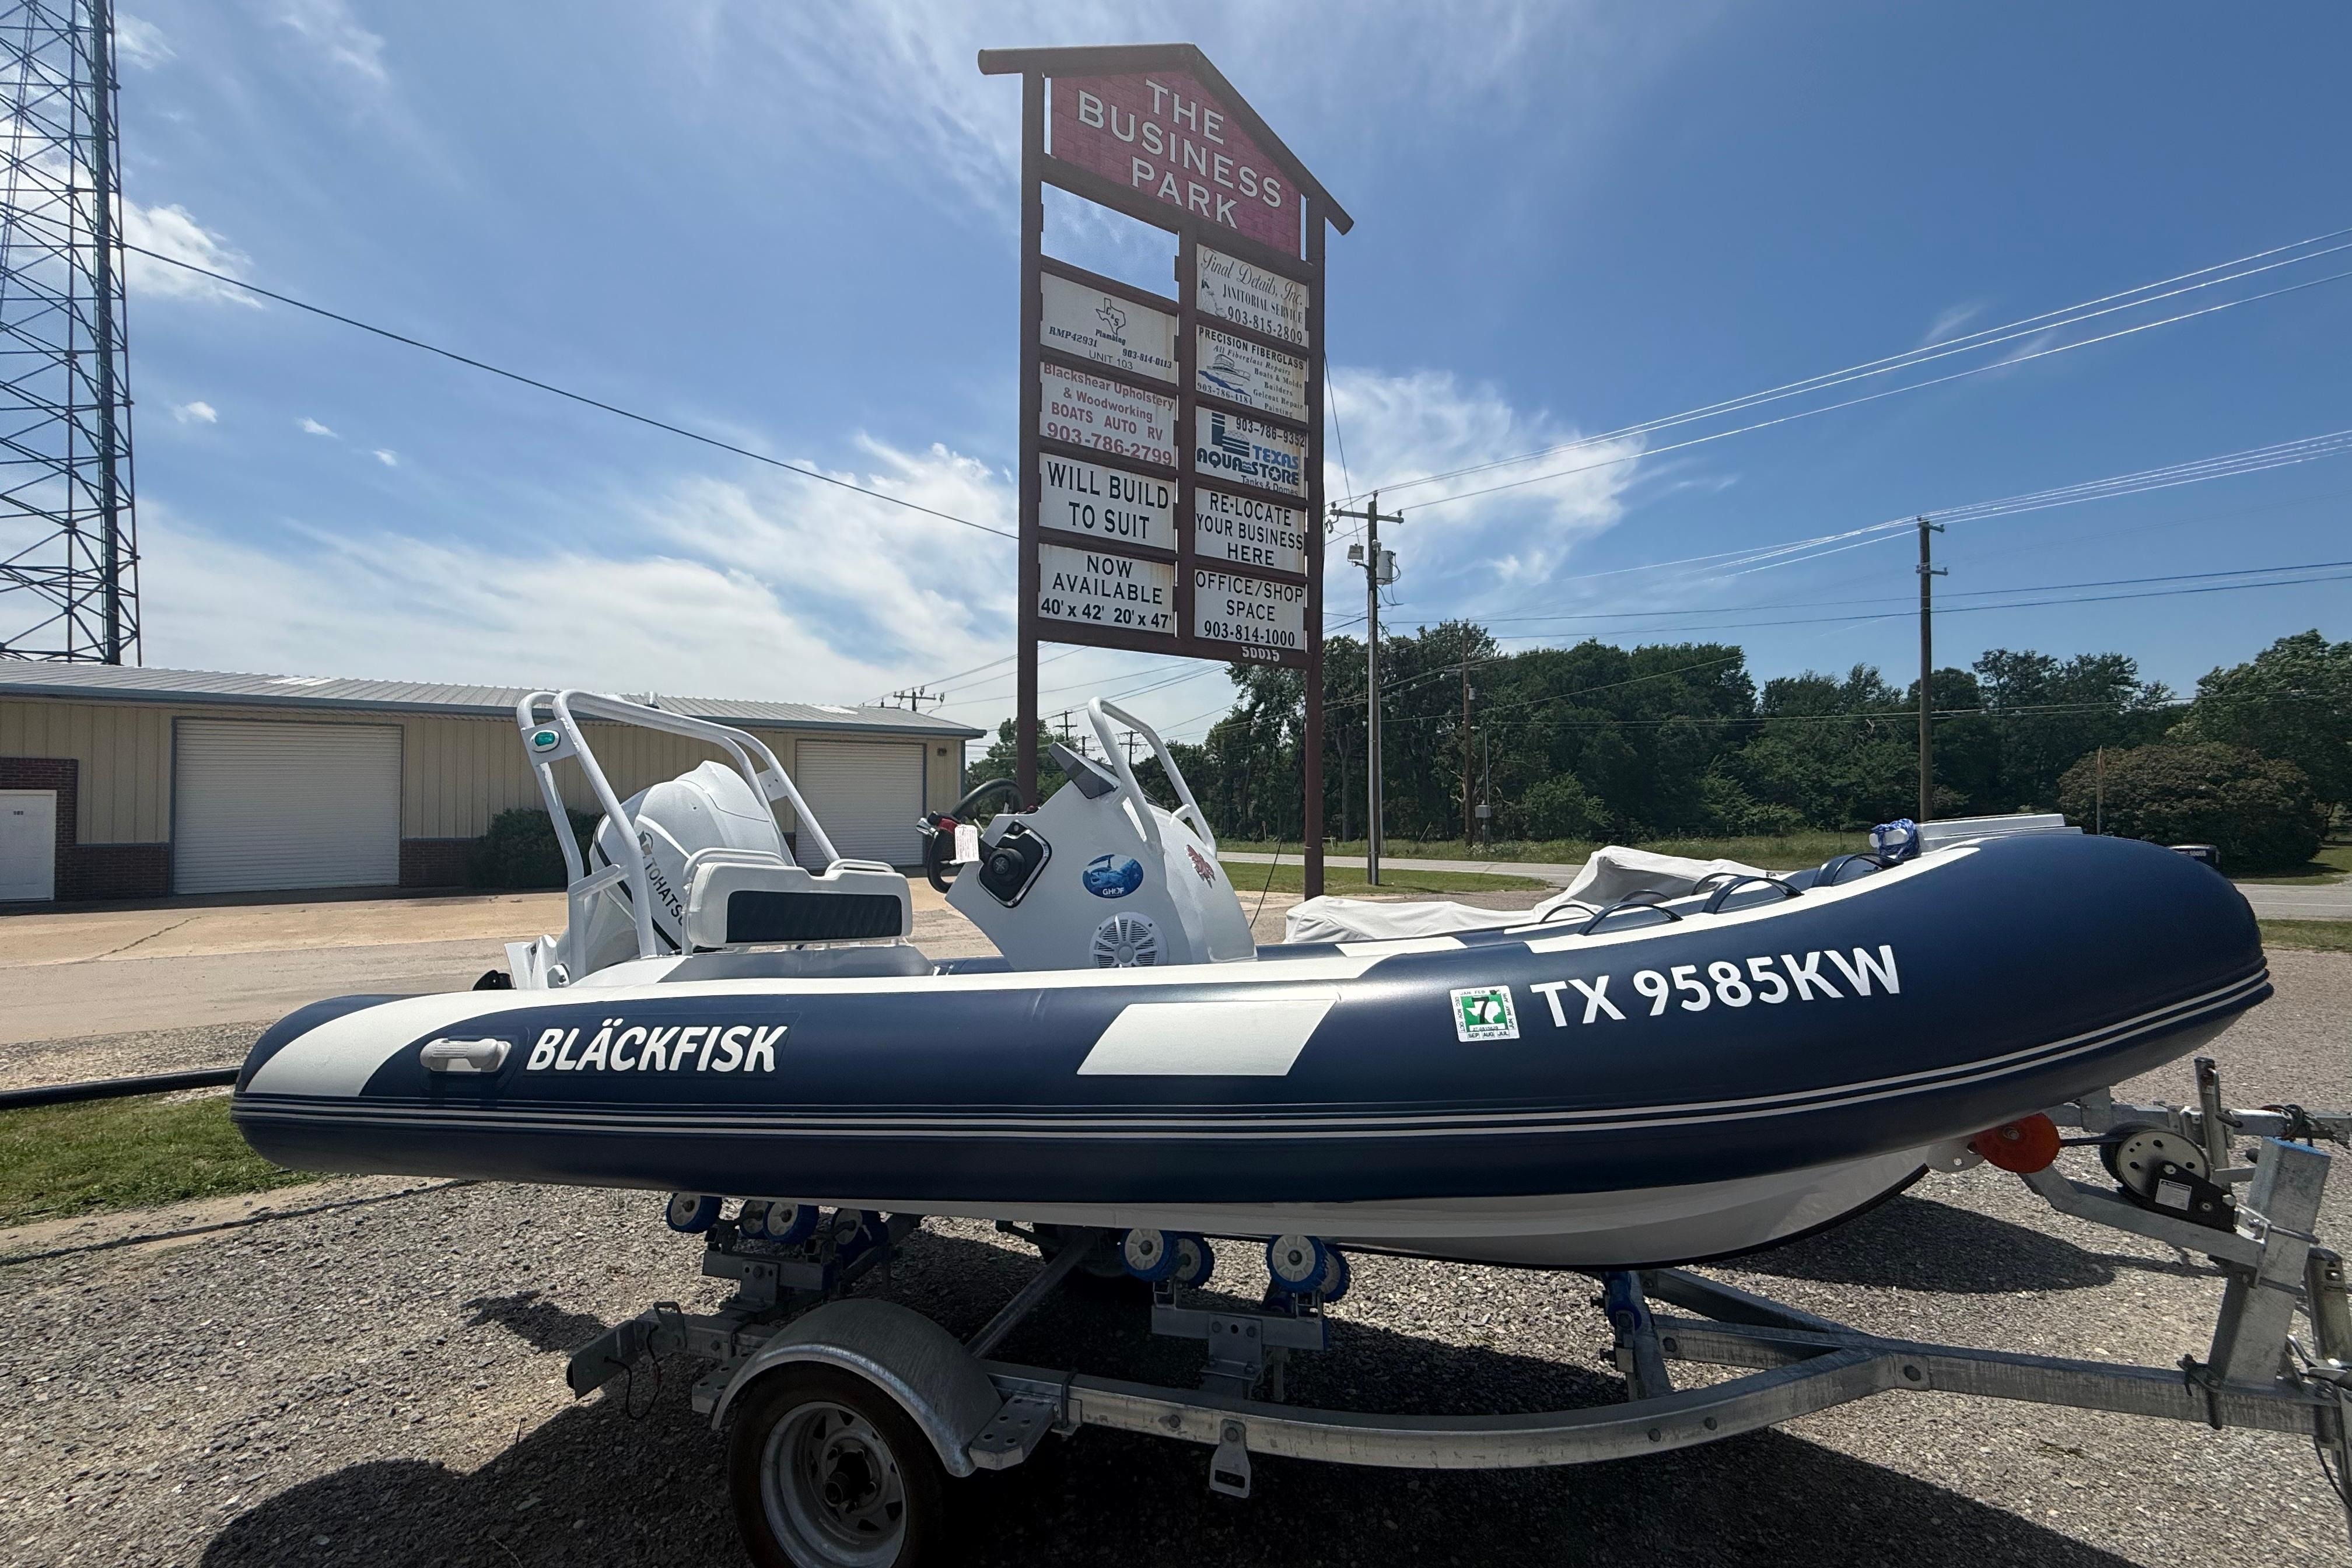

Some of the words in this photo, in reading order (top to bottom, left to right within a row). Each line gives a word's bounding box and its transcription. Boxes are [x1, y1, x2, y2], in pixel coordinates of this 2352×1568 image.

[1145, 79, 1224, 145] THE
[1078, 90, 1282, 208] BUSINESS
[1131, 156, 1238, 229] PARK
[1201, 249, 1234, 278] Final
[1280, 281, 1303, 306] Inc.
[1223, 284, 1268, 312] JANITORIAL
[1271, 302, 1303, 324] SERVICE
[1049, 326, 1097, 347] RMP42931
[1096, 329, 1126, 346] Plumbing
[1228, 306, 1302, 344] 903-815-2809
[1089, 350, 1113, 364] UNIT
[1116, 359, 1133, 370] 103
[1122, 348, 1172, 368] 903-814-0113
[1199, 327, 1248, 351] PRECISION
[1251, 345, 1304, 370] FIBERGLASS
[1213, 345, 1225, 354] All
[1227, 349, 1262, 366] Fiberglass
[1265, 361, 1291, 376] Repairs
[1044, 363, 1111, 391] Blackshear
[1114, 382, 1174, 411] Upholstery
[1254, 368, 1273, 380] Boats
[1283, 377, 1303, 389] Molds
[1264, 382, 1293, 396] Builders
[1063, 387, 1072, 399] &
[1076, 390, 1153, 423] Woodworking
[1253, 389, 1279, 402] Gelcoat
[1281, 397, 1304, 410] Repair
[1265, 403, 1293, 418] Painting
[1051, 402, 1093, 424] BOATS
[1104, 415, 1137, 434] AUTO
[1147, 426, 1163, 440] RV
[1236, 418, 1304, 447] 903-786-9352
[1047, 422, 1172, 466] 903-786-2799
[1252, 444, 1298, 470] TEXAS
[1047, 461, 1100, 496] WILL
[1110, 475, 1168, 509] BUILD
[1241, 475, 1263, 489] Tanks
[1266, 481, 1270, 490] &
[1273, 483, 1298, 496] Domes
[1069, 502, 1095, 528] TO
[1105, 509, 1149, 539] SUIT
[1210, 492, 1291, 527] RE-LOCATE
[1196, 513, 1232, 537] YOUR
[1239, 523, 1303, 550] BUSINESS
[1087, 555, 1133, 578] NOW
[1228, 542, 1274, 566] HERE
[1052, 573, 1162, 604] AVAILABLE
[1196, 571, 1303, 603] OFFICE/SHOP
[1041, 598, 1063, 615] 40'
[1068, 605, 1076, 617] x
[1083, 604, 1104, 620] 42'
[1114, 608, 1134, 624] 20'
[1138, 615, 1146, 626] x
[1151, 613, 1171, 628] 47'
[1227, 600, 1275, 621] SPACE
[1205, 621, 1294, 646] 903-814-1000
[1241, 646, 1280, 662] 50015
[1530, 975, 1626, 1027] TX
[1633, 944, 1900, 1017] 9585KW
[1472, 996, 1489, 1024] 7
[526, 1018, 788, 1073] BLÄCKFISK
